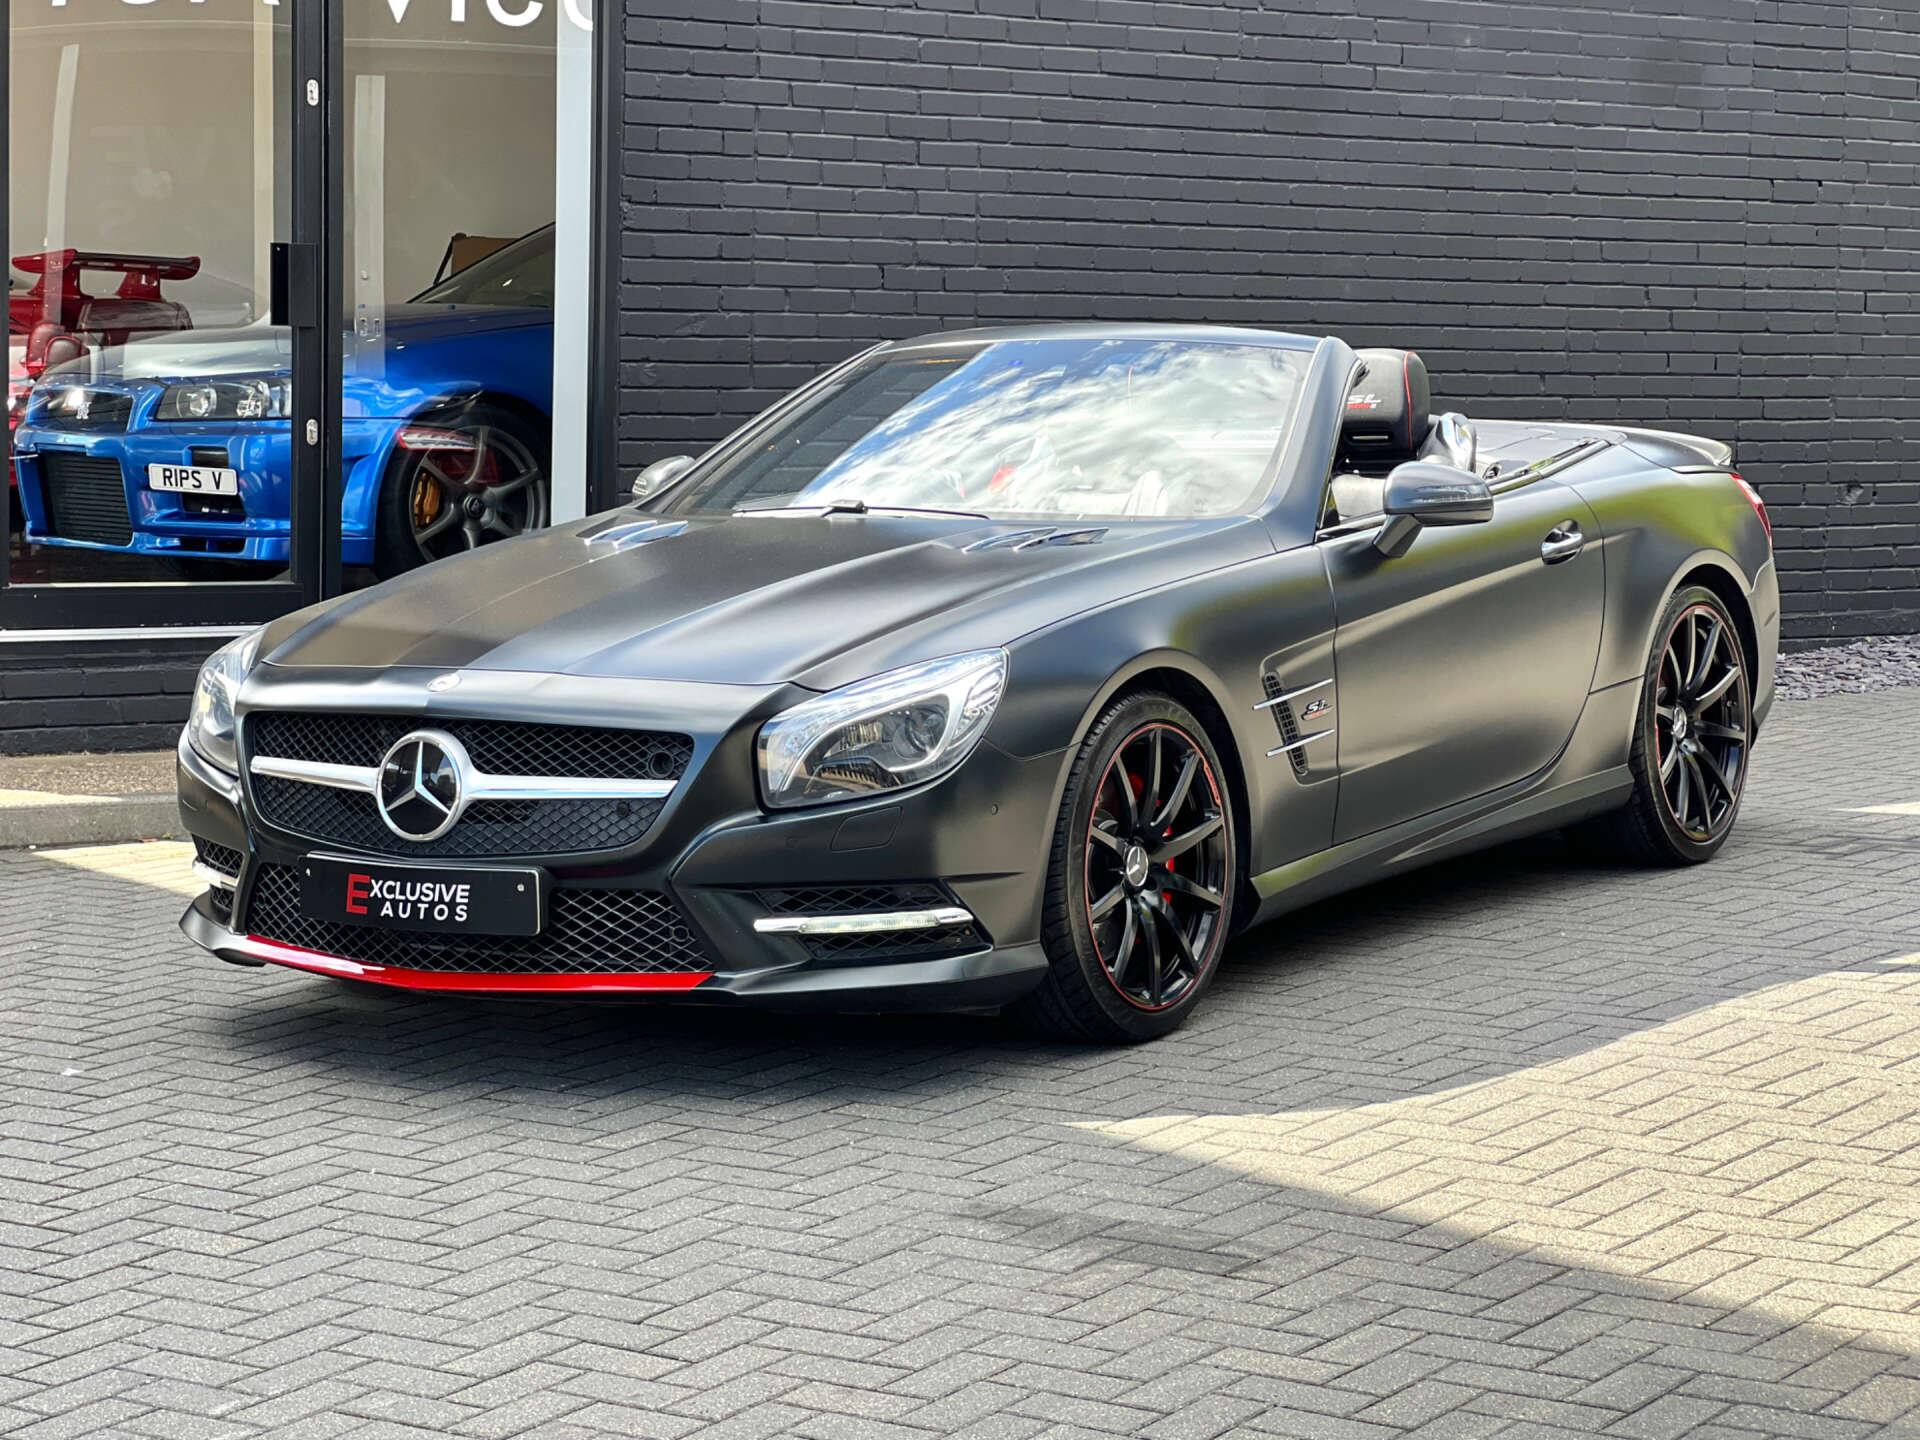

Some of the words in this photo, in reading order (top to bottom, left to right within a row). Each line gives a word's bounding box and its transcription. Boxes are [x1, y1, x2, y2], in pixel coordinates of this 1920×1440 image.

[162, 467, 202, 489] RIPS
[211, 471, 222, 490] V
[346, 873, 470, 915] EXCLUSIVE
[380, 901, 468, 922] AUTOS
